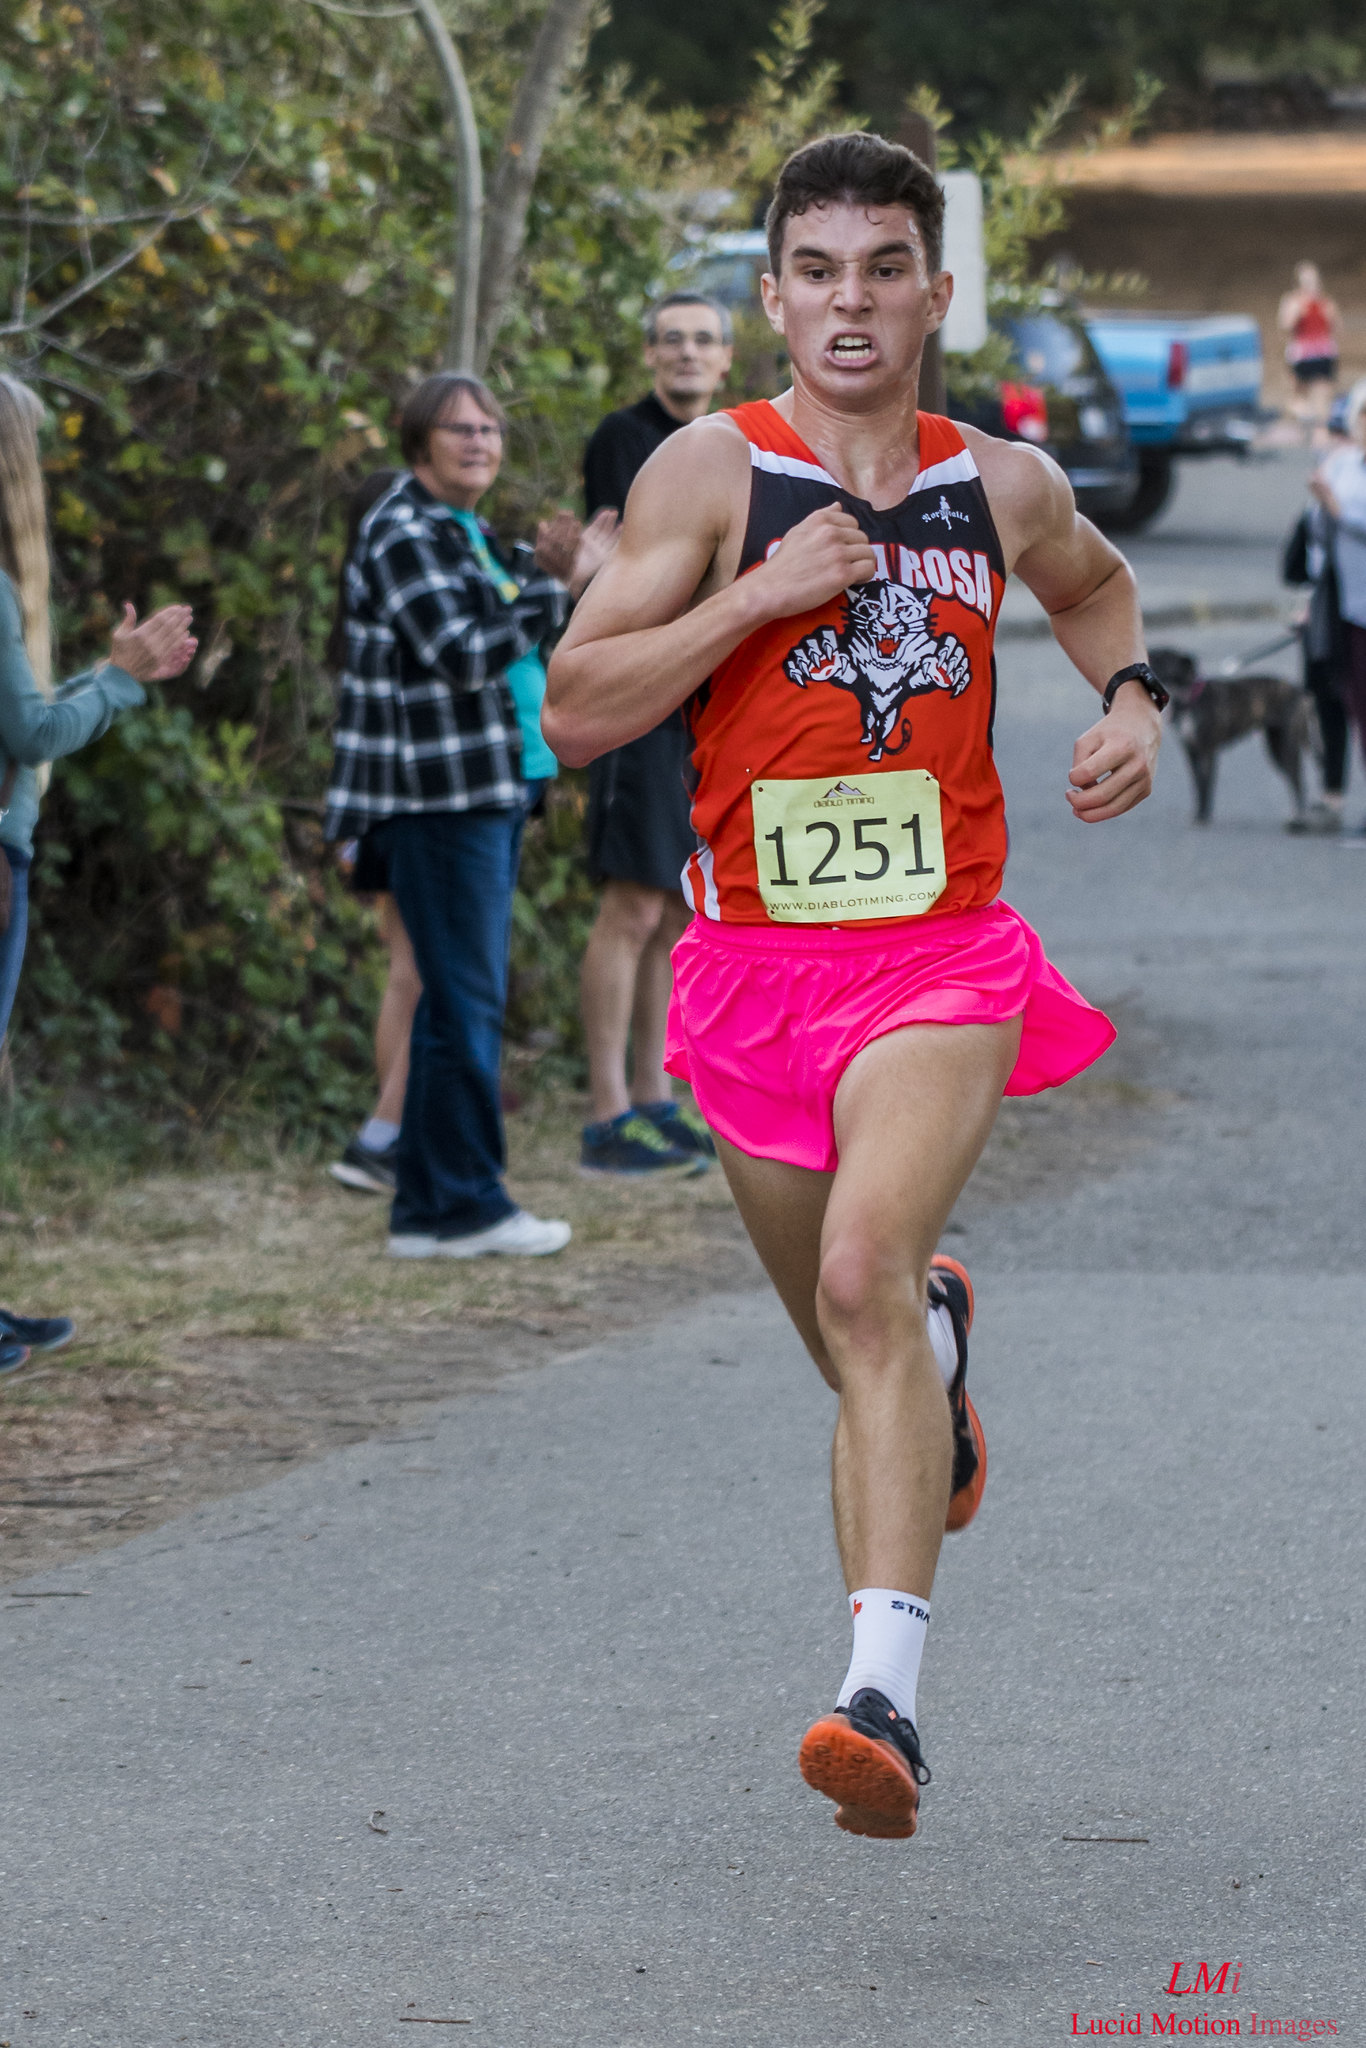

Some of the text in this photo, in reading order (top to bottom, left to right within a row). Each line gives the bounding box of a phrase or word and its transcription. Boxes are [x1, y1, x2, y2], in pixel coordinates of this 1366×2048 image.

[898, 543, 991, 622] ROSA
[765, 813, 935, 886] 1251
[769, 891, 938, 911] WWW.DIABLOTIMING.COM
